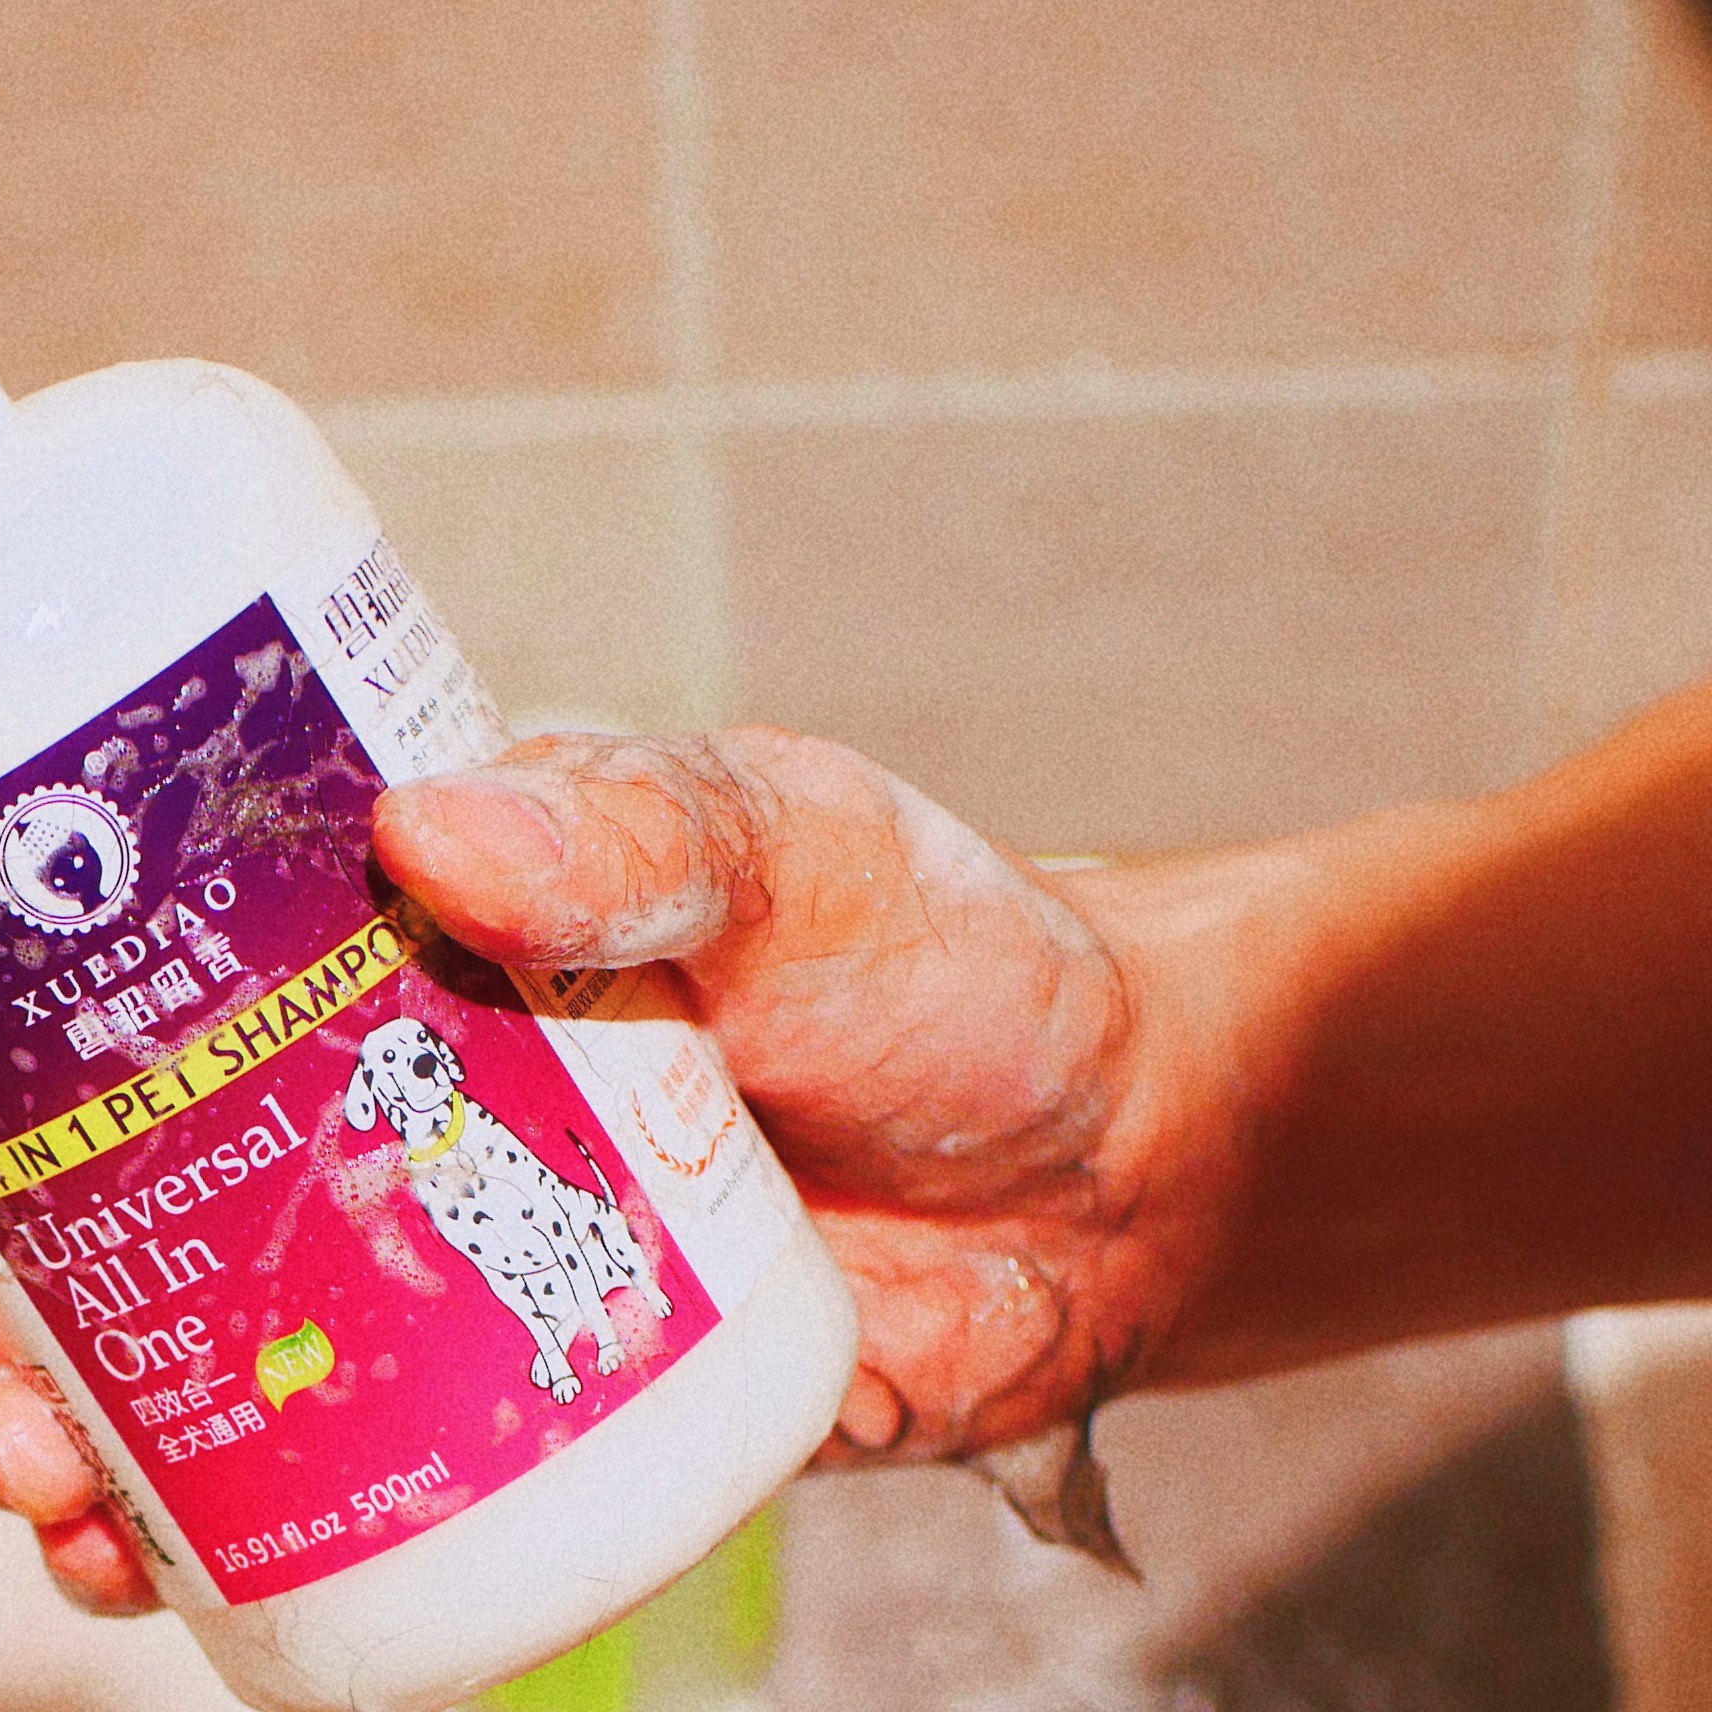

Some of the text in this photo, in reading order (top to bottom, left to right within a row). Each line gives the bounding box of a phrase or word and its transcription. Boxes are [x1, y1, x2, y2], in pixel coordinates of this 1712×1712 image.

[361, 604, 440, 713] XUEDI
[11, 877, 237, 1028] XUEDIAO
[62, 931, 244, 1062] 雪貂留香
[6, 1132, 62, 1180] IN
[67, 1114, 97, 1153] 1
[102, 1056, 197, 1136] PET
[13, 1092, 308, 1270] Universal
[66, 1236, 226, 1329] All In
[94, 1313, 214, 1382] One
[129, 1372, 237, 1428] 四效合一
[262, 1334, 325, 1397] NEW
[156, 1400, 267, 1464] 全犬通用
[214, 1531, 286, 1574] 16.91
[349, 1450, 451, 1523] 500ml
